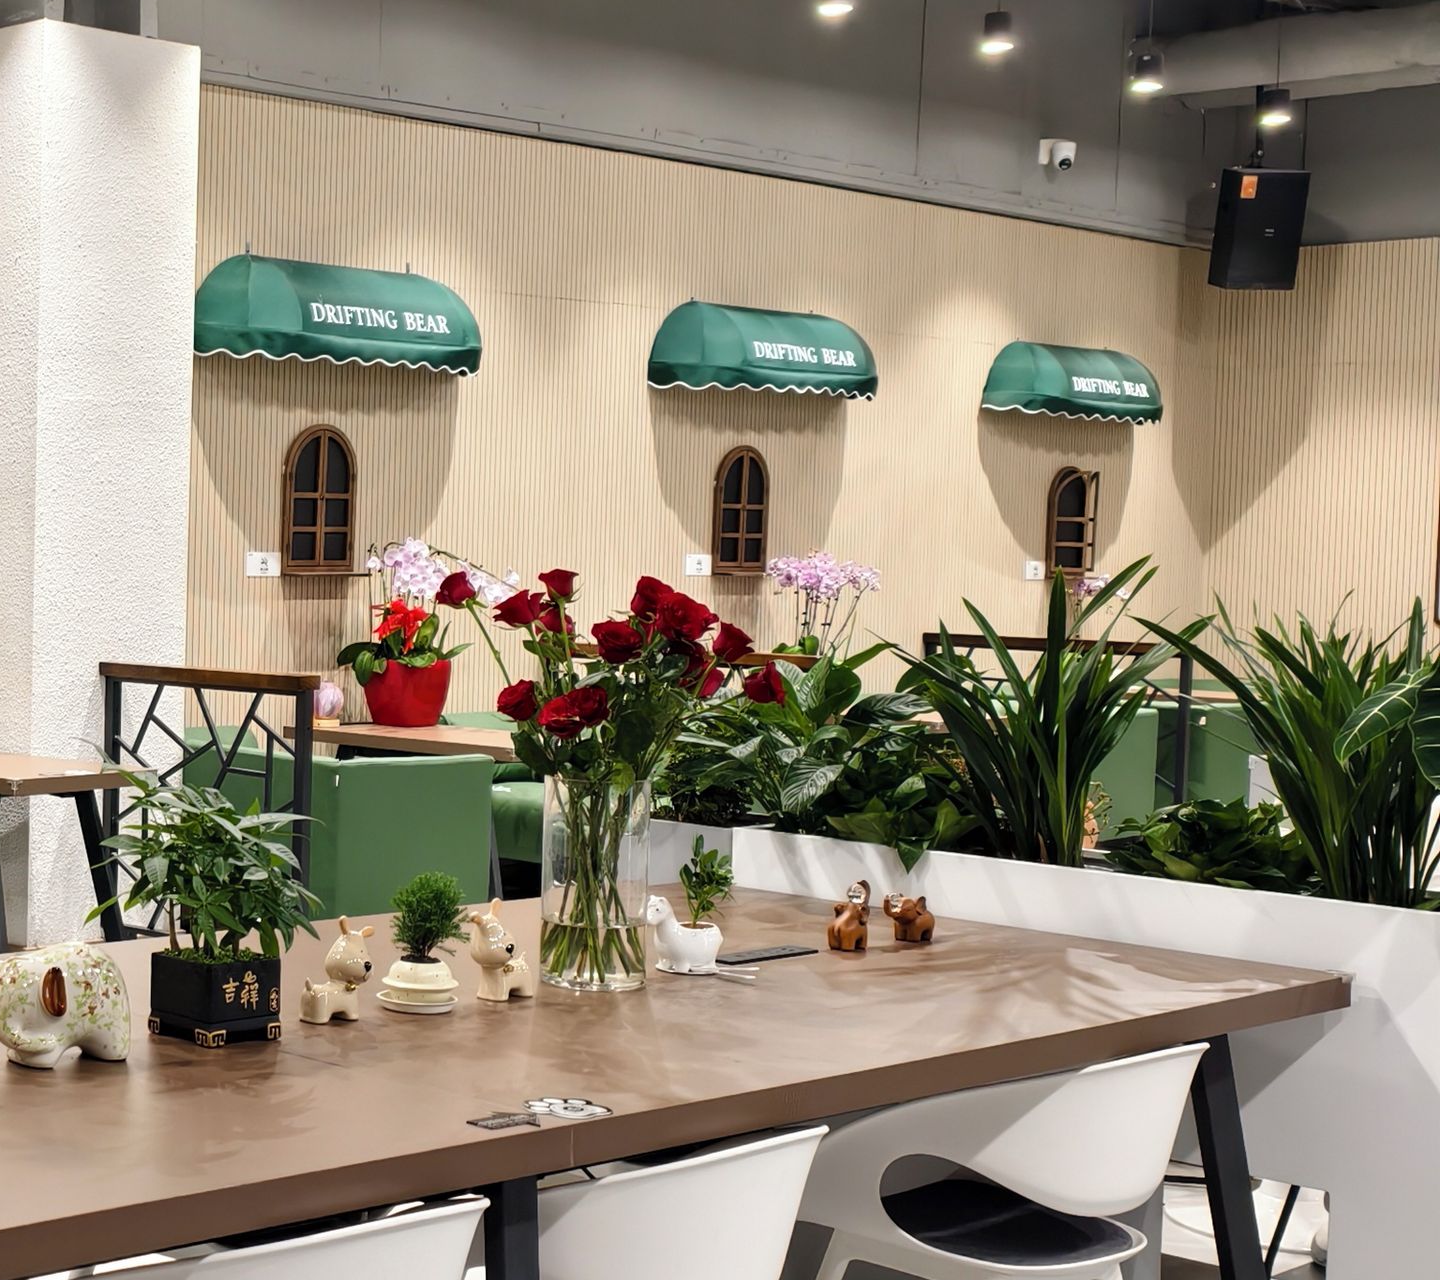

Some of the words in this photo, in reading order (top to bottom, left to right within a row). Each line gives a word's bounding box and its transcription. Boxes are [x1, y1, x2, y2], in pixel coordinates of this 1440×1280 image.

[310, 302, 398, 330] DRIFTING
[403, 311, 451, 335] BEAR
[753, 341, 819, 363] DRIFTING
[821, 347, 857, 367] BEAR
[1071, 376, 1121, 395] DRIFTING
[222, 970, 259, 1010] 吉祥
